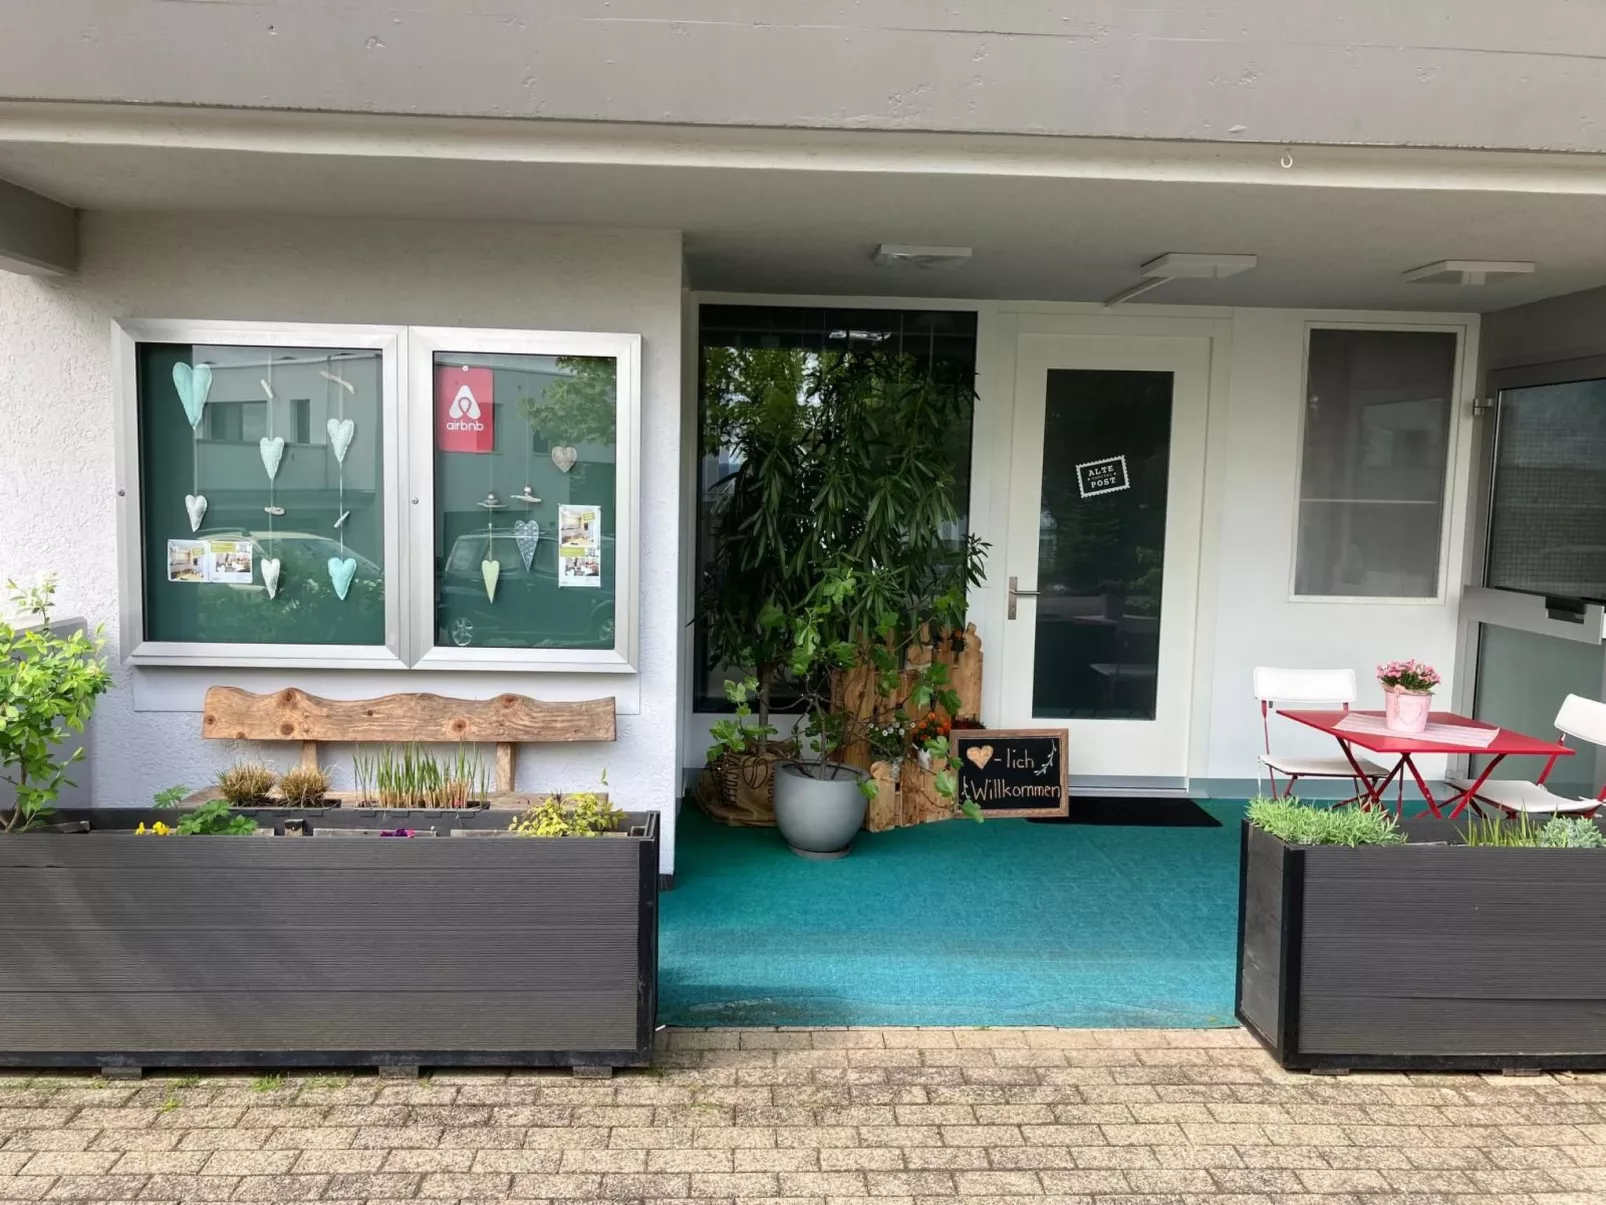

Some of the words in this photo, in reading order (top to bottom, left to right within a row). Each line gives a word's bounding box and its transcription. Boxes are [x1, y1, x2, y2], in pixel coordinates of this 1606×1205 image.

[446, 420, 484, 431] airbnb
[1088, 465, 1114, 477] ALTE
[1090, 476, 1116, 489] POST
[970, 778, 1061, 801] Willkommen
